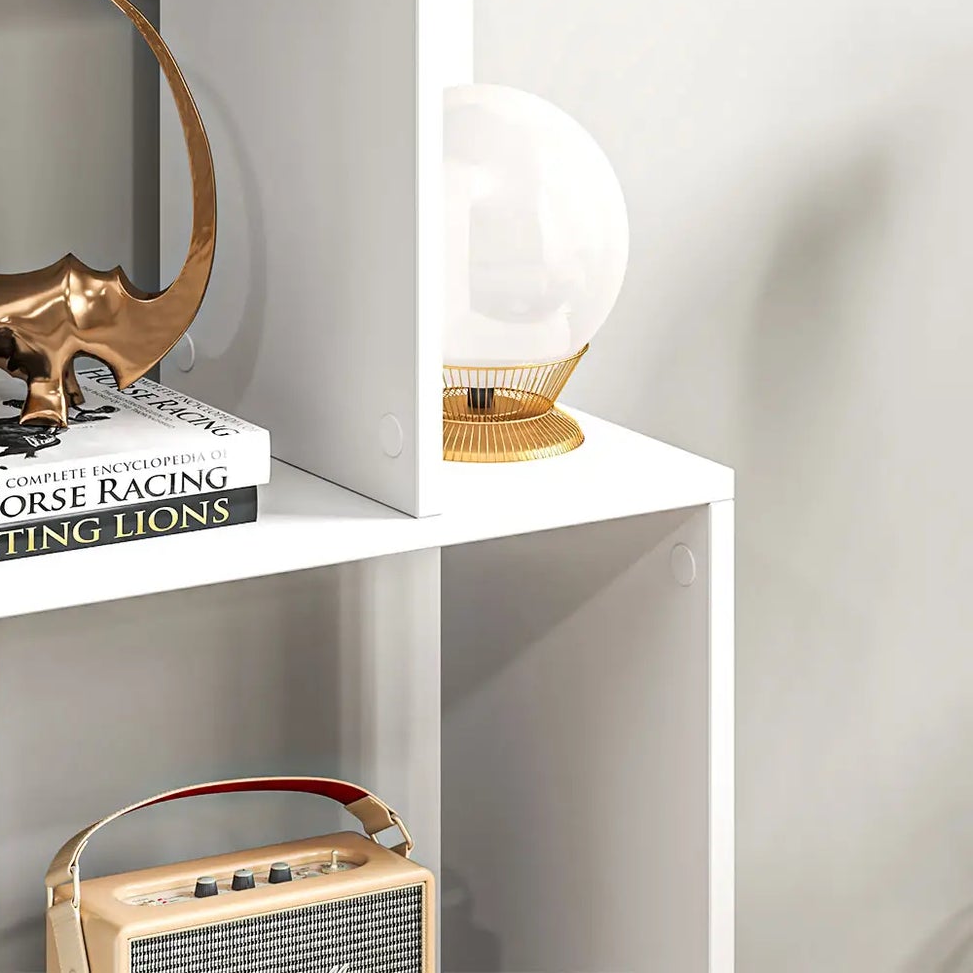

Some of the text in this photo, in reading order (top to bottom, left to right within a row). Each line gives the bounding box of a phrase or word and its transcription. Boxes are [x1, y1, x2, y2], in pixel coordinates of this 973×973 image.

[147, 399, 240, 437] RACING
[6, 468, 87, 489] COMPLETE
[92, 452, 207, 477] ENCYCLOPEDIA
[97, 466, 228, 505] RACING
[113, 497, 231, 539] LIONS
